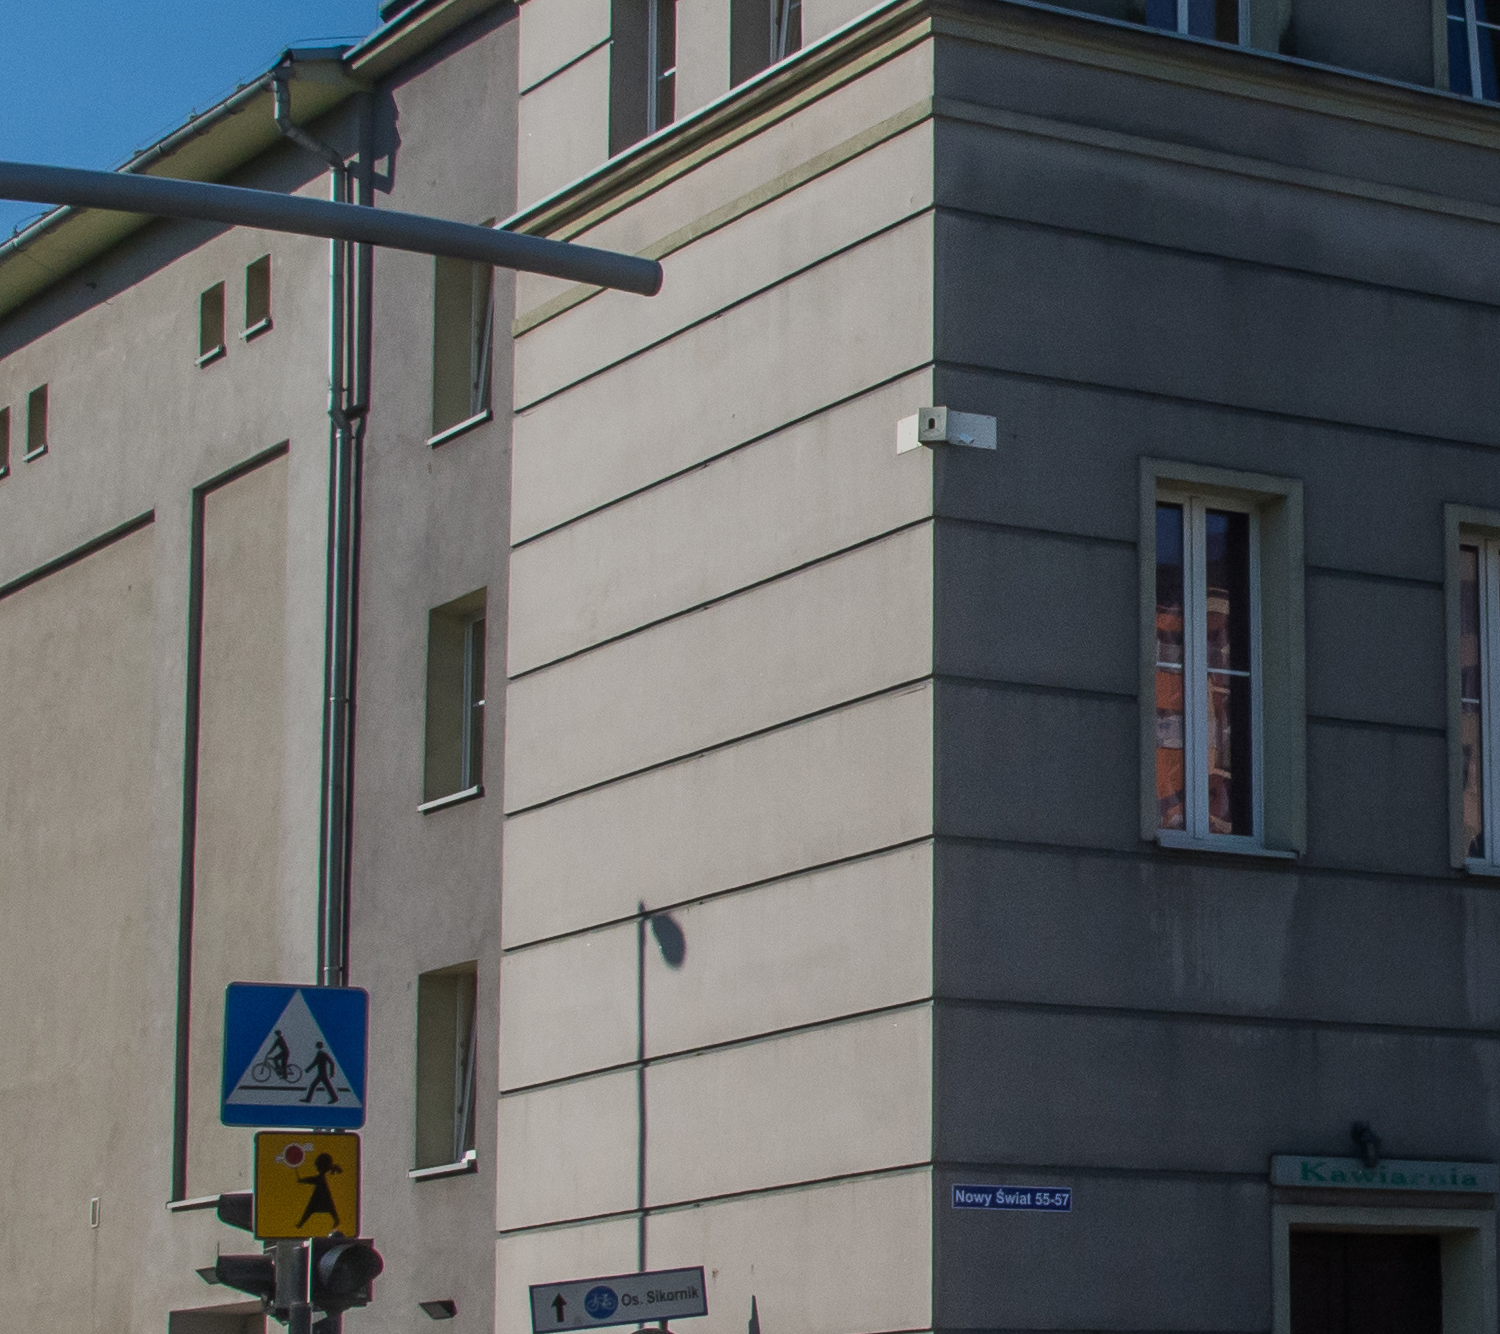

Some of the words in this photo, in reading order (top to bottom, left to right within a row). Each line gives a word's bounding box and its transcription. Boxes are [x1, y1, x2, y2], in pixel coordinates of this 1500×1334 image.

[1300, 1161, 1478, 1186] Kawiarnia
[955, 1189, 992, 1207] Nowy
[995, 1188, 1032, 1205] Świat
[1035, 1192, 1070, 1206] 55-57
[620, 1293, 644, 1307] Os.
[646, 1285, 699, 1305] Sikornik
